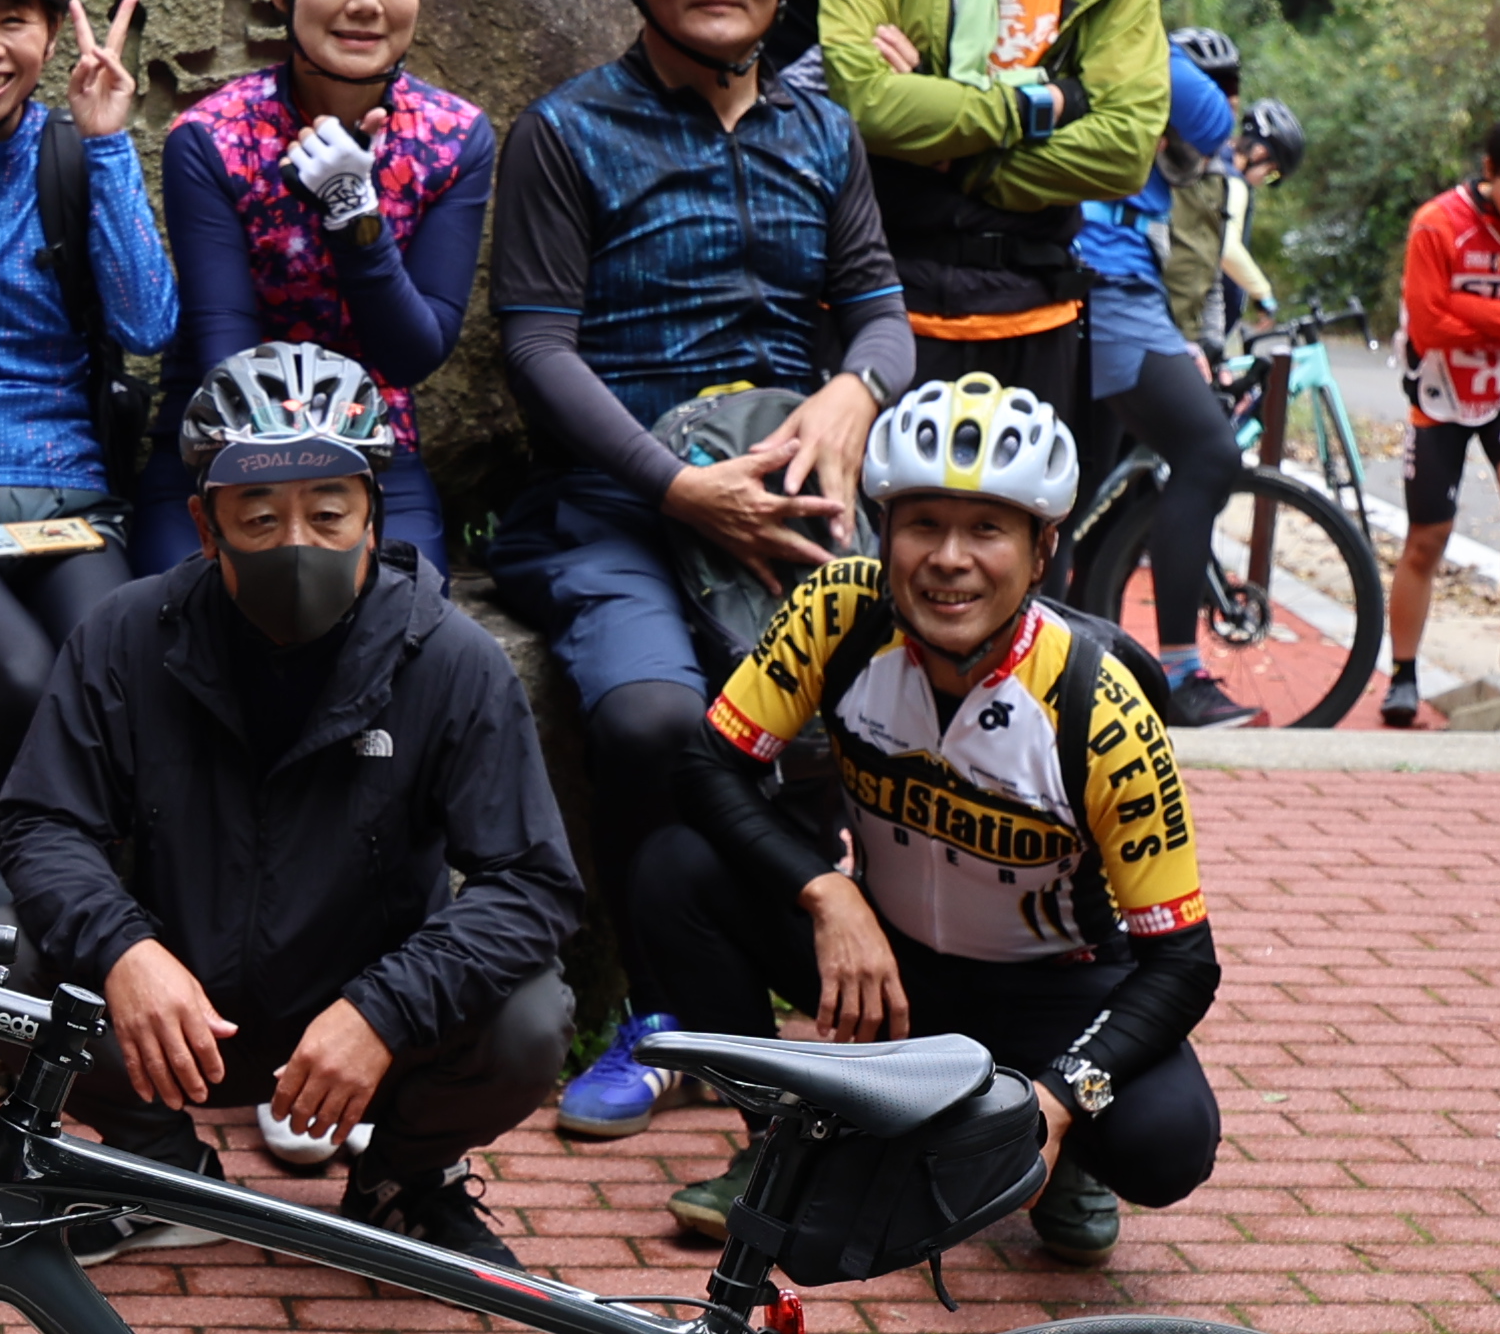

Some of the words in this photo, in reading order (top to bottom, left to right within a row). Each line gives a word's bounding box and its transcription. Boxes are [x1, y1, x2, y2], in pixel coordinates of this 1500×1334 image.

[236, 451, 293, 474] PEDAL
[297, 450, 341, 468] DAY
[842, 765, 897, 816] est
[904, 781, 1080, 867] Station
[1134, 713, 1190, 853] Station
